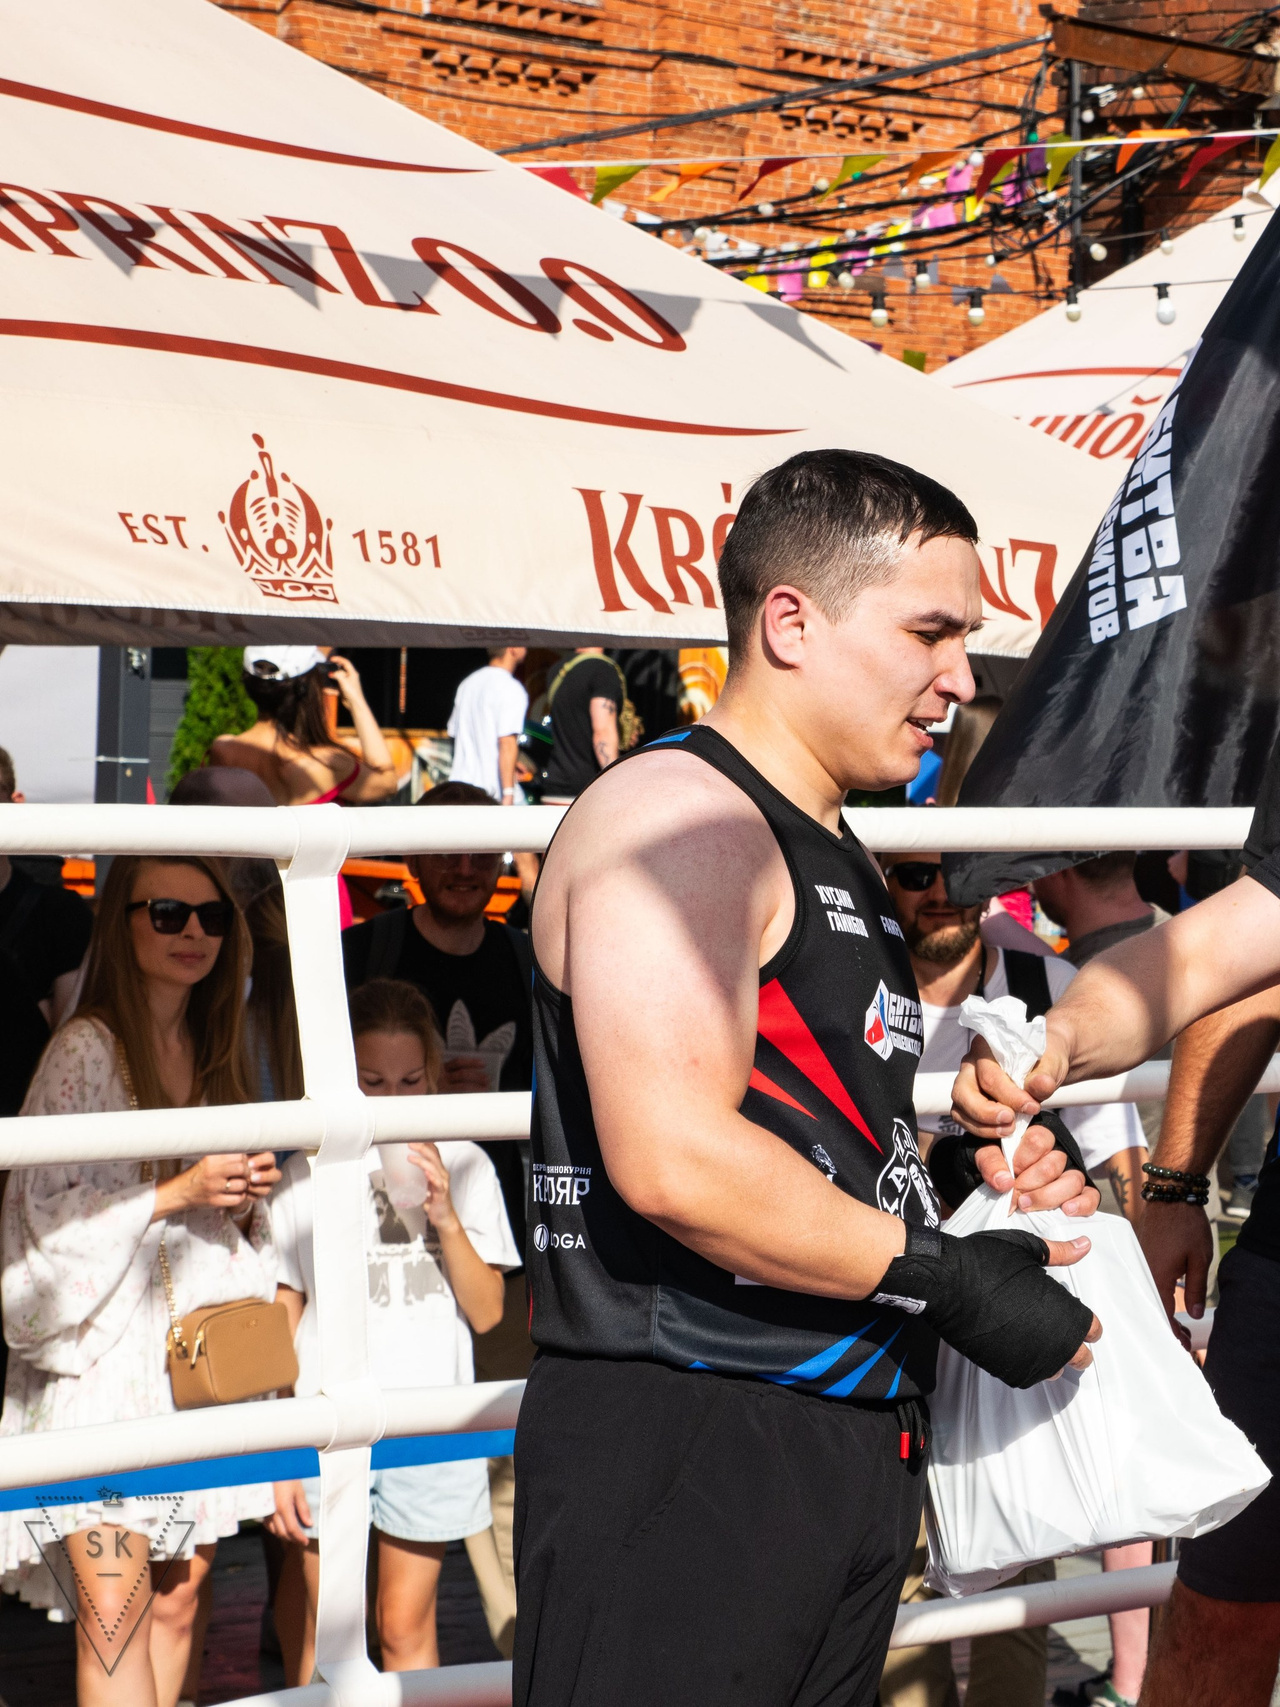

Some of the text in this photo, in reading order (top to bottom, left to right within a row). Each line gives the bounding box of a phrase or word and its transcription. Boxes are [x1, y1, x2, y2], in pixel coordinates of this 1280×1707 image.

[0, 182, 441, 316] PRINZ
[118, 511, 441, 569] EST. 1581
